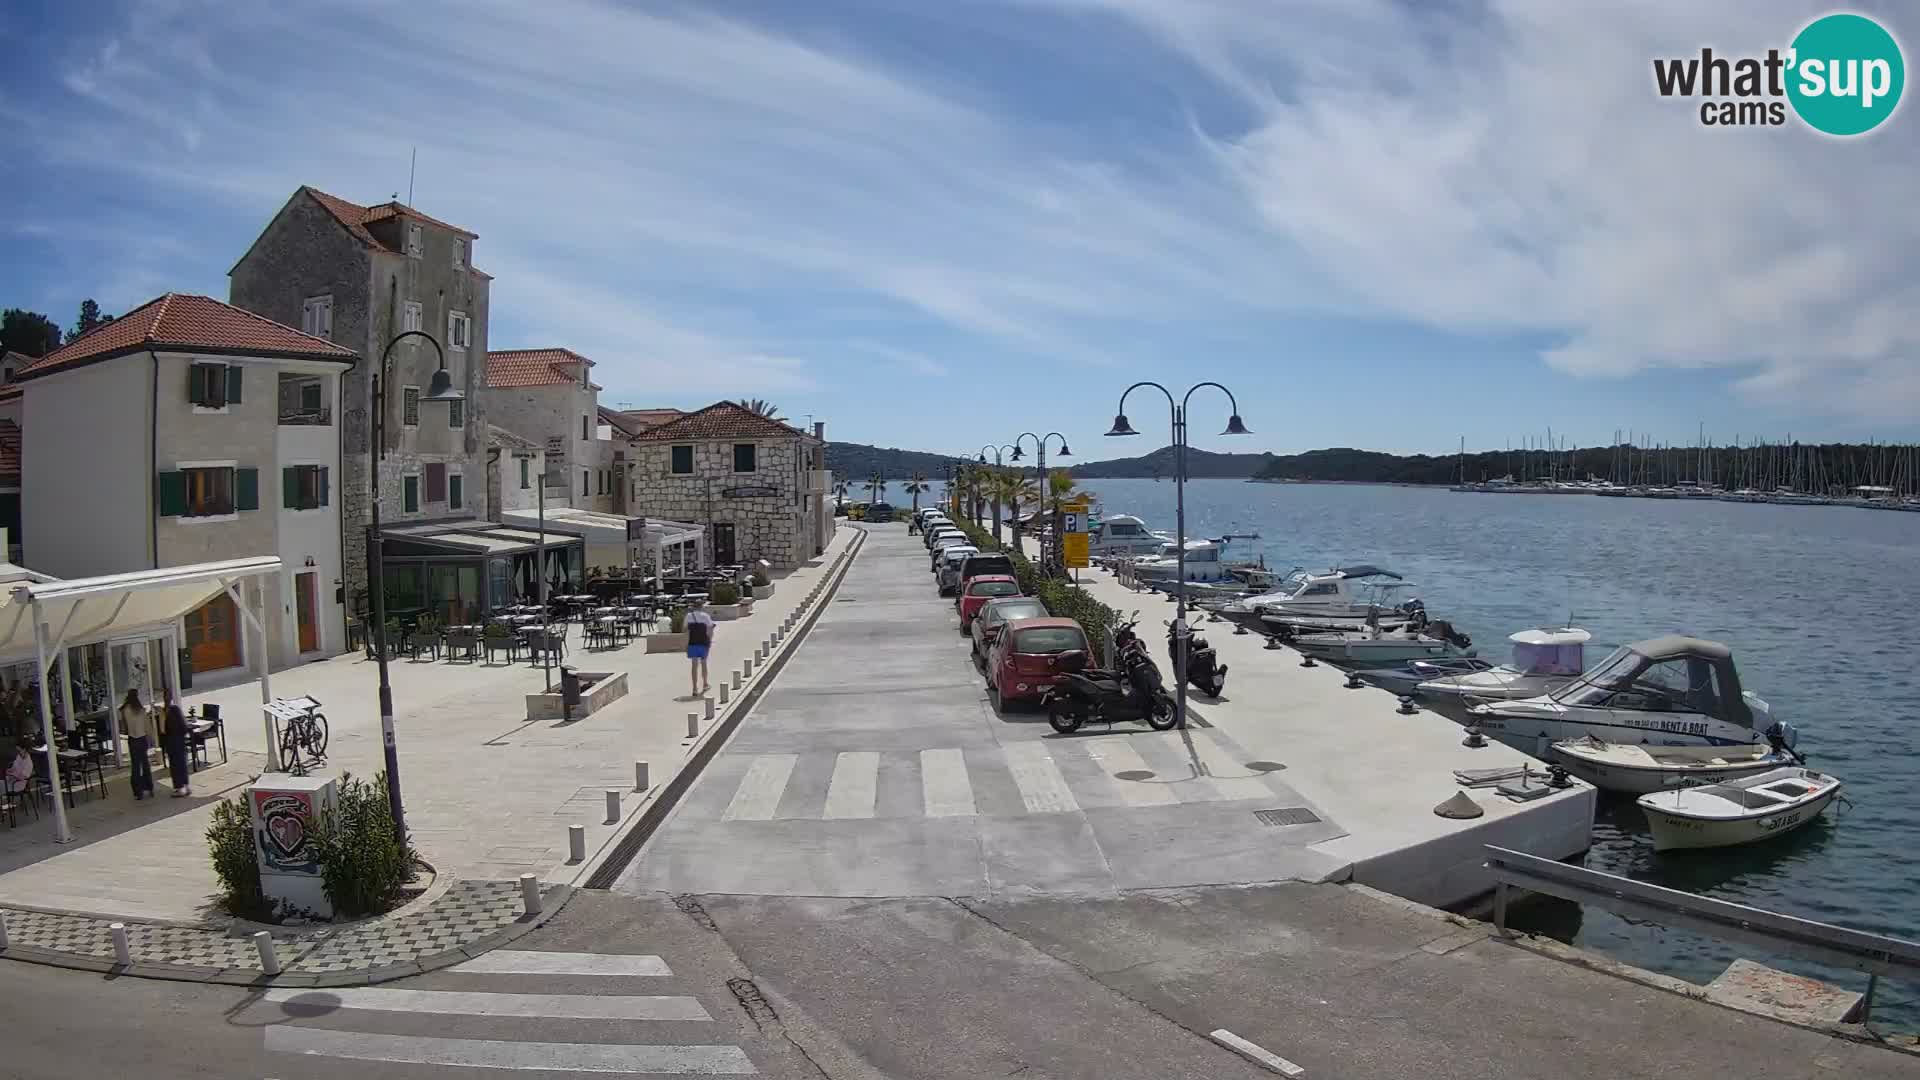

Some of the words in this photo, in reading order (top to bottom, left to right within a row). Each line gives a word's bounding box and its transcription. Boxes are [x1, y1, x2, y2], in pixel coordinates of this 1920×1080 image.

[1065, 514, 1076, 531] P
[1660, 720, 1681, 731] RENT
[1688, 722, 1709, 735] BOAT
